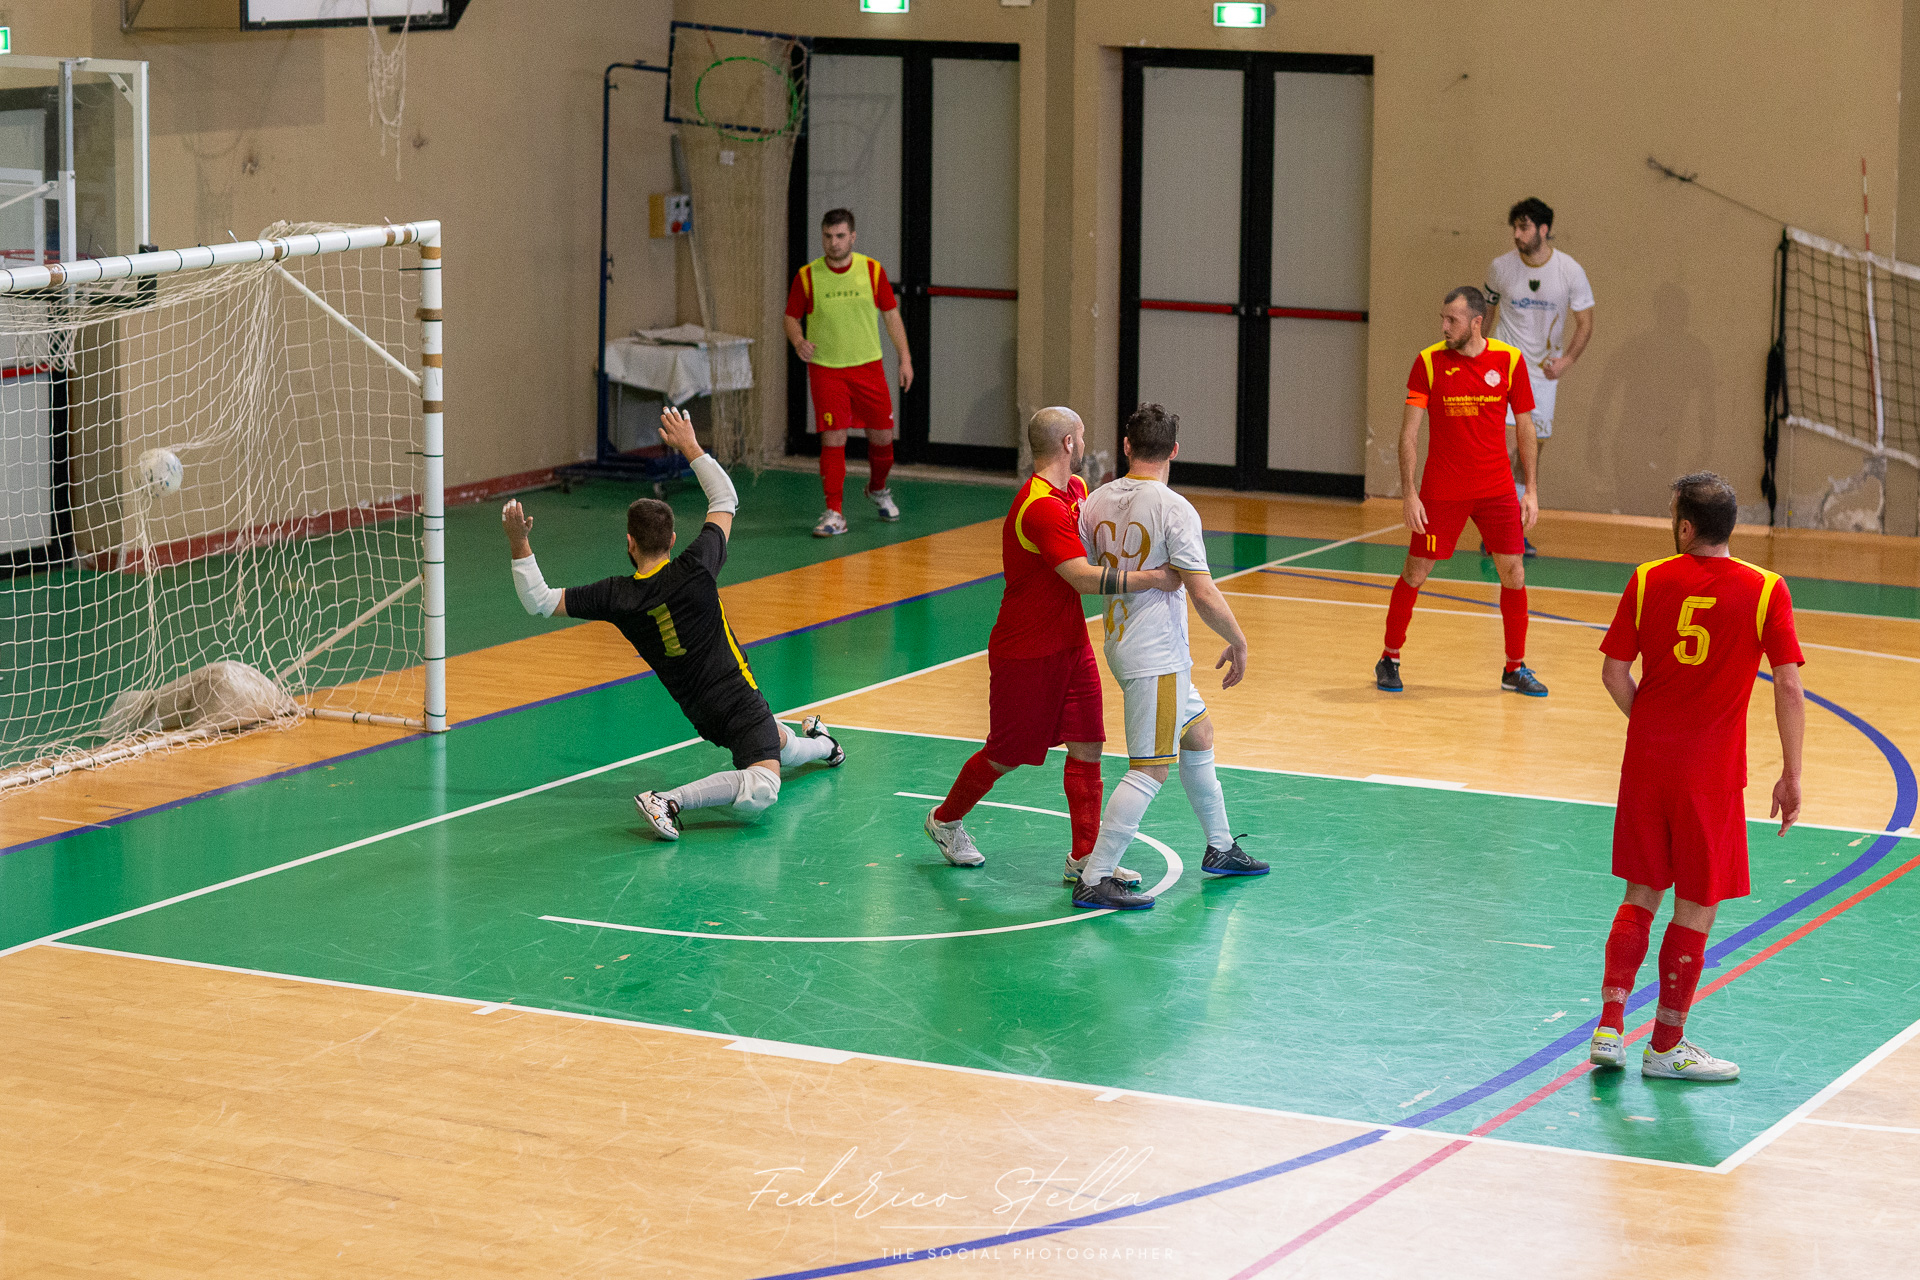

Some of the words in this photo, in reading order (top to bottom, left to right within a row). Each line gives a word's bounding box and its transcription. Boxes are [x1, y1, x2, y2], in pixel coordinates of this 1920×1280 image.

[823, 412, 833, 426] 9
[1093, 520, 1151, 571] 69
[1426, 534, 1437, 552] 11
[647, 602, 687, 657] 1
[1673, 595, 1717, 666] 5
